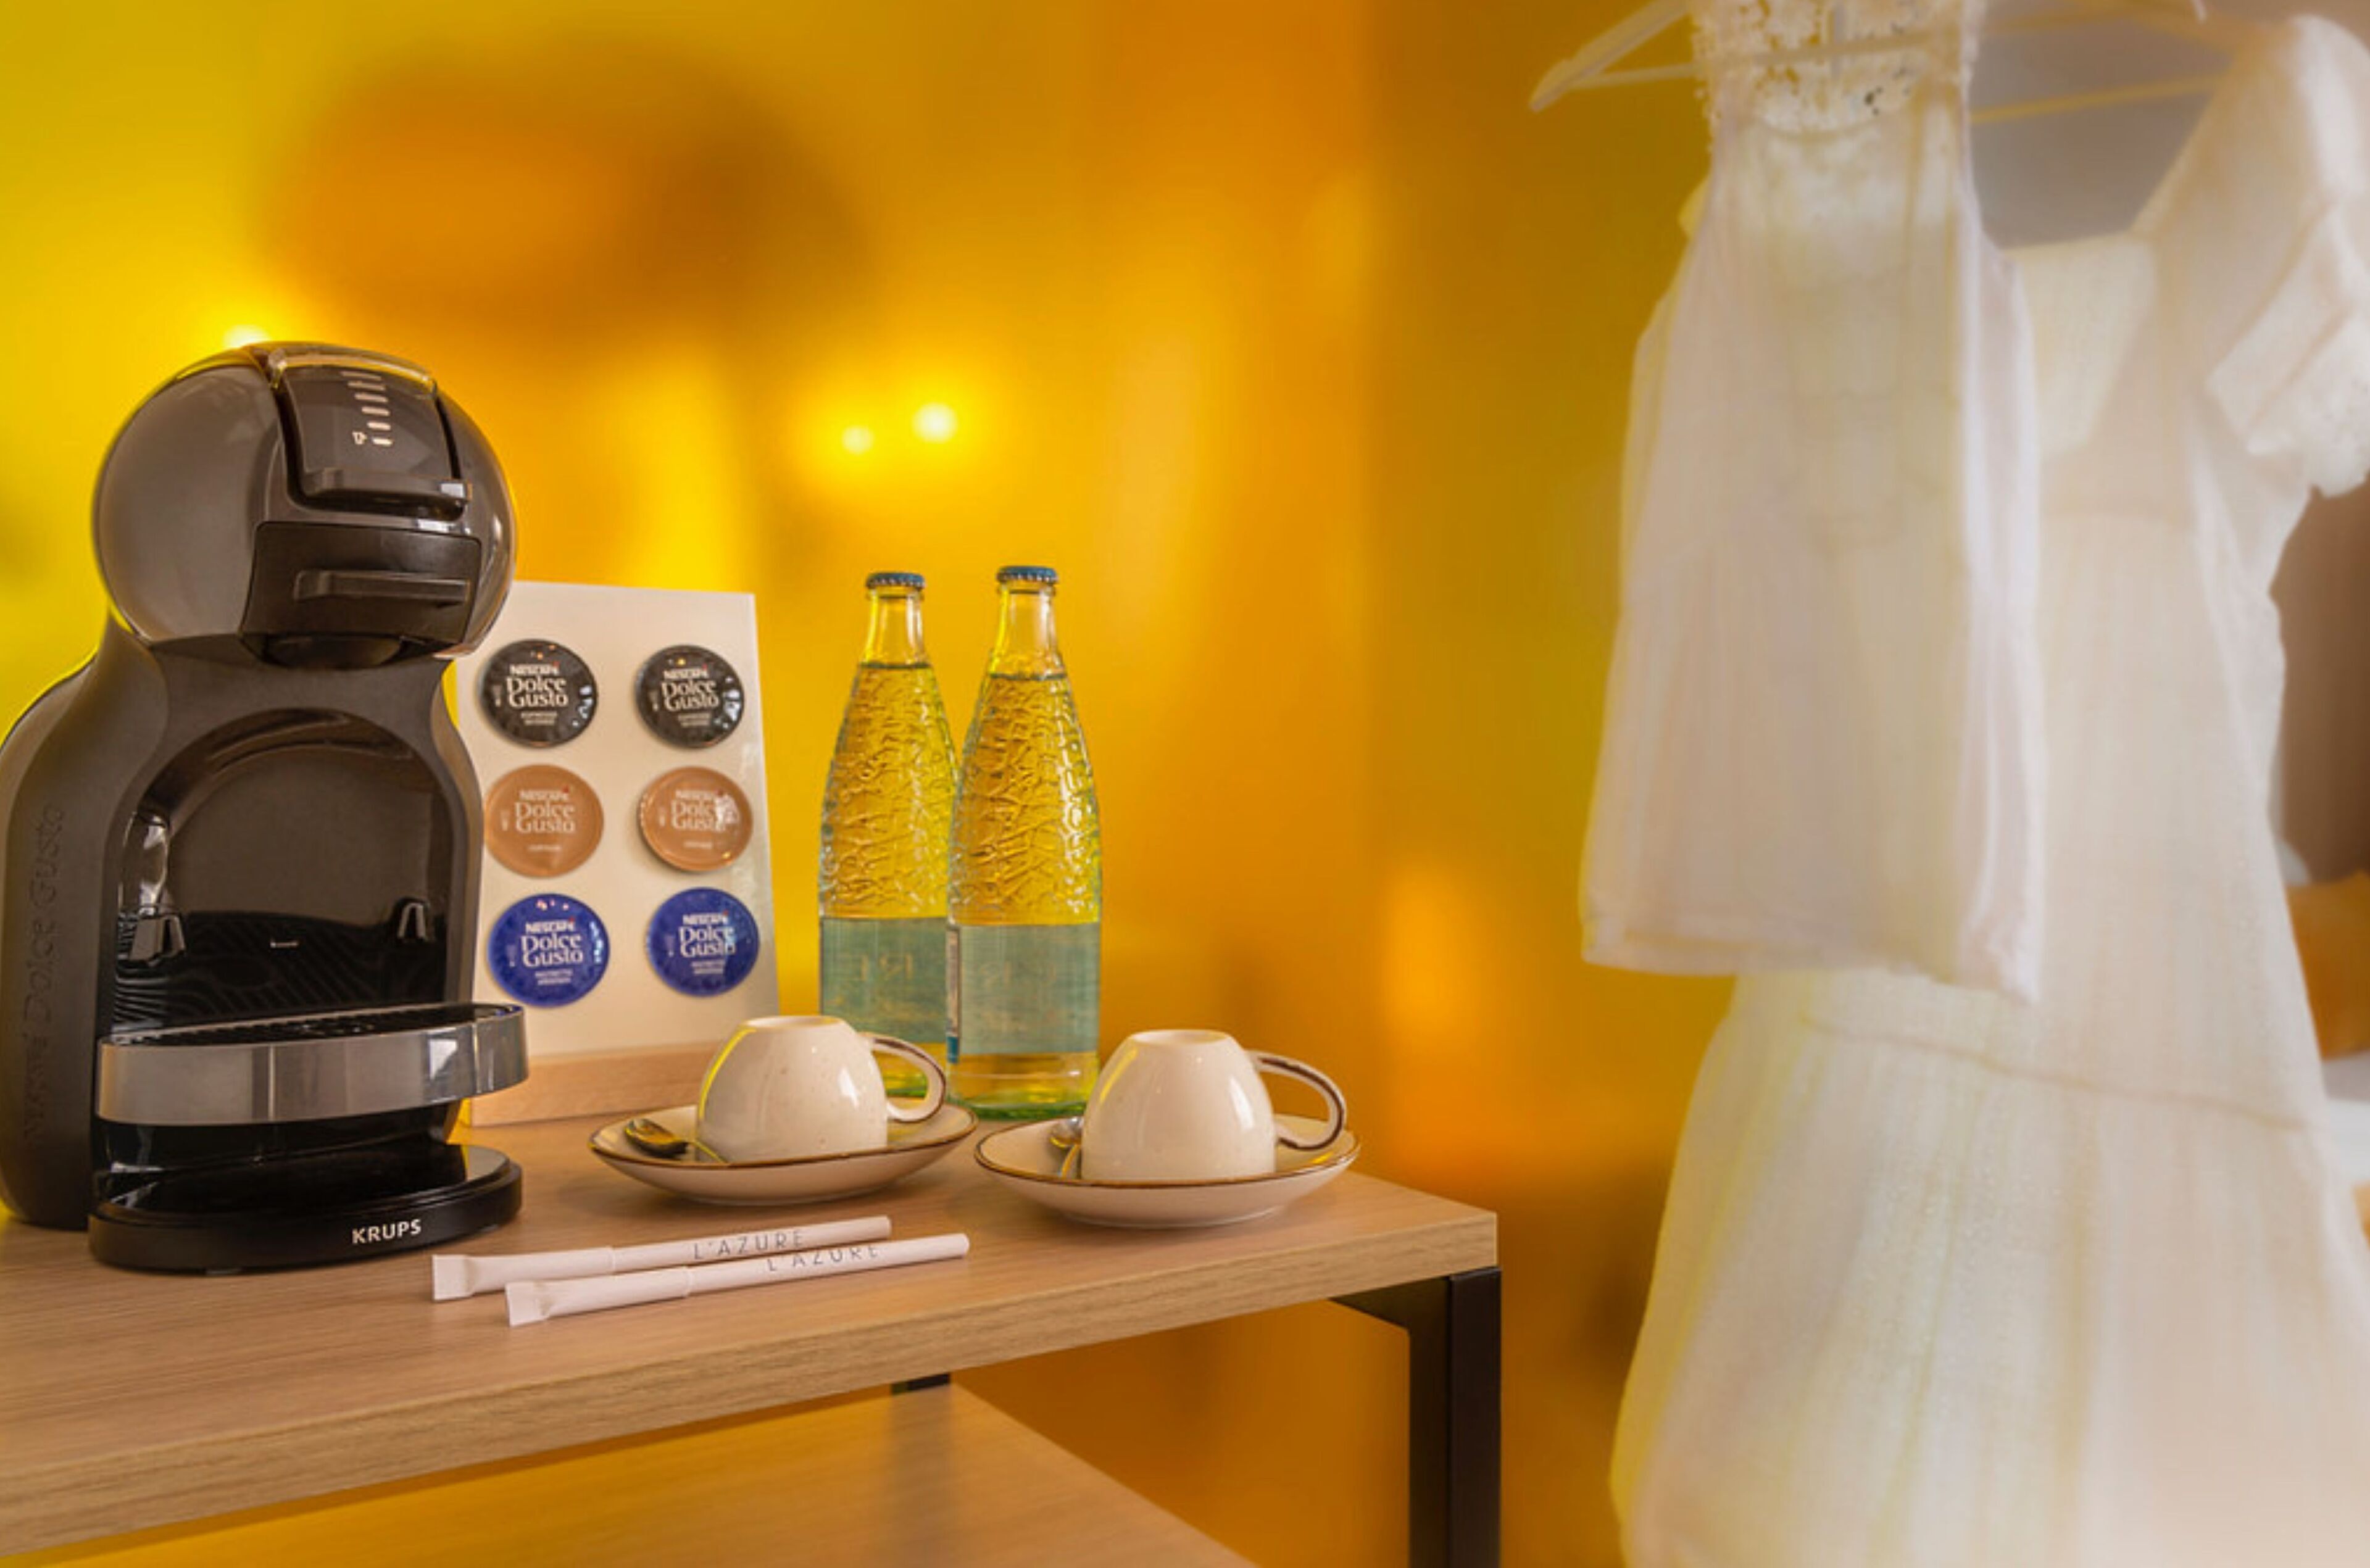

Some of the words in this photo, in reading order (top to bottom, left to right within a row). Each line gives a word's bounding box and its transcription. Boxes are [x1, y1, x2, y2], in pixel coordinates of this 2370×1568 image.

[506, 676, 567, 692] Dolce
[661, 679, 716, 697] Dolce
[508, 689, 568, 707] Gusto
[663, 691, 719, 711] Gusto
[515, 801, 575, 818] Dolce
[516, 815, 576, 833] Gusto
[521, 932, 582, 951] Dolce
[679, 926, 736, 942] Dolce
[523, 946, 583, 968] Gusto
[680, 939, 737, 958] Gusto
[351, 1218, 422, 1245] KRUPS
[693, 1230, 805, 1260] L'AZURE
